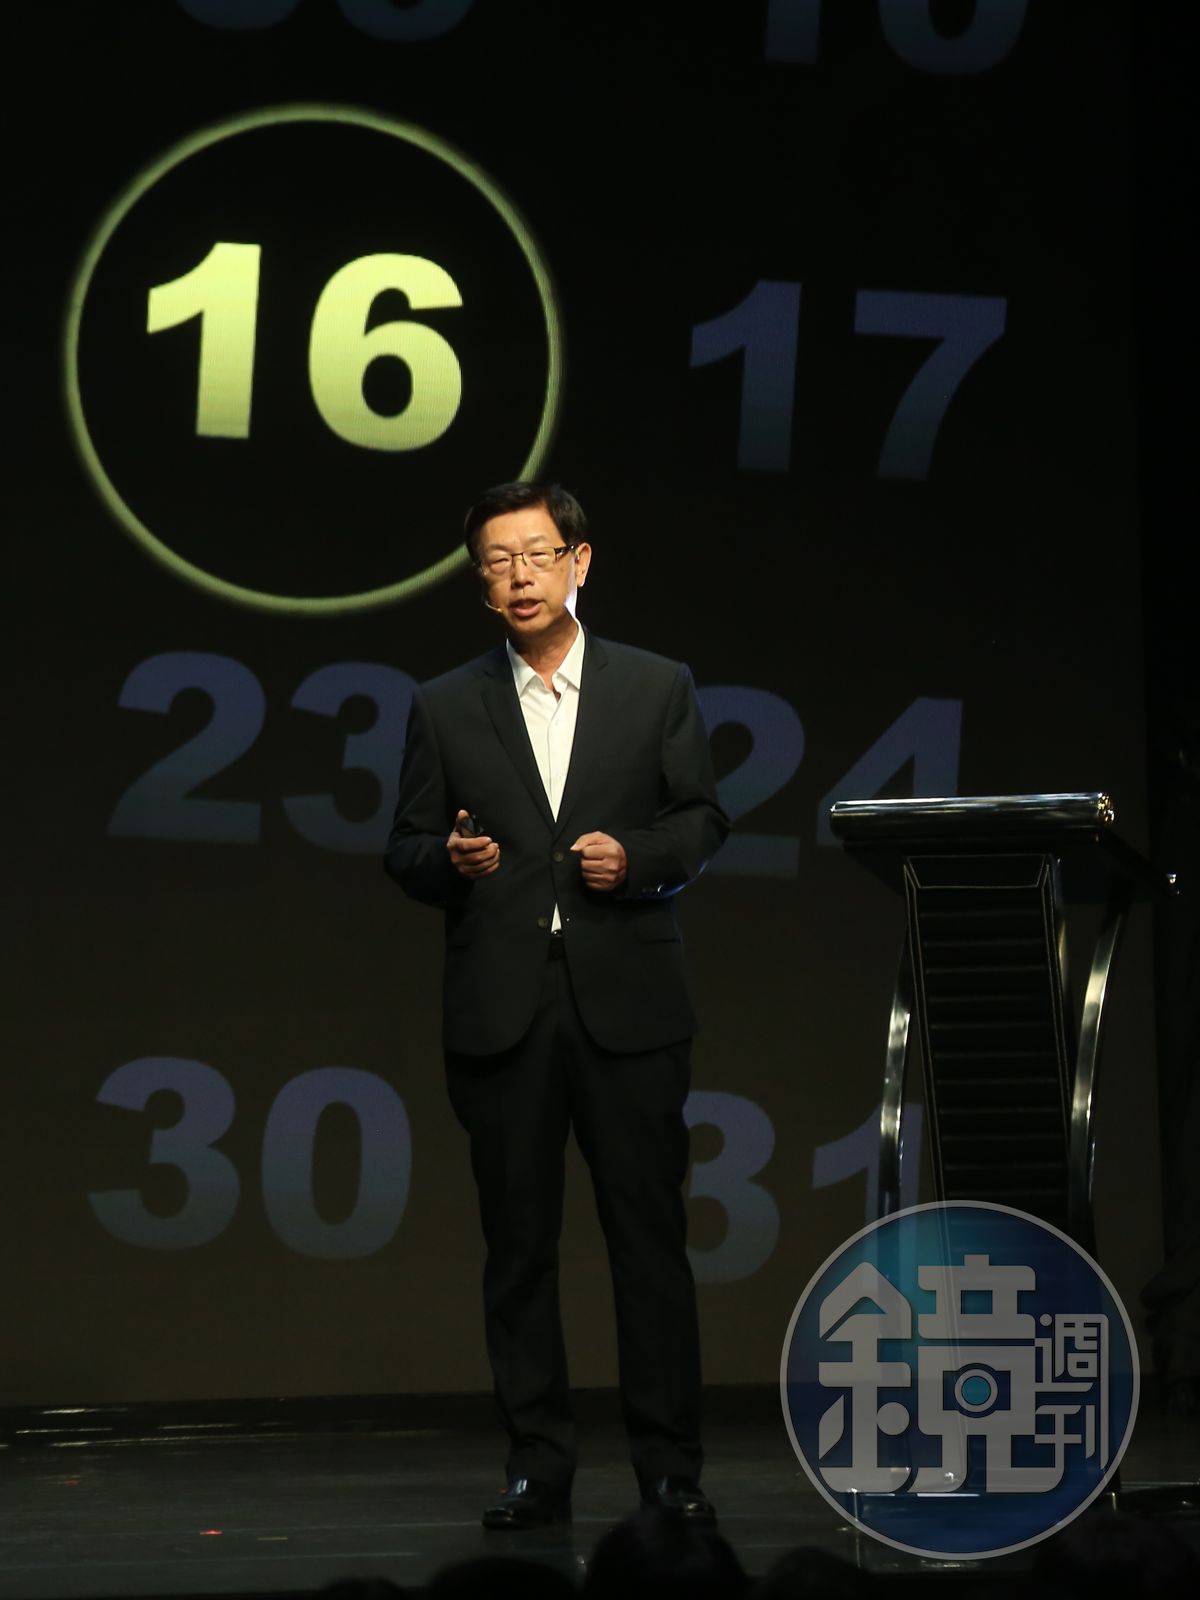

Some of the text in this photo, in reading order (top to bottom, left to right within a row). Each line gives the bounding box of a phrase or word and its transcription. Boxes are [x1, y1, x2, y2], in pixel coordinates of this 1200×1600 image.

[146, 241, 463, 453] 16
[689, 279, 1007, 481] 17
[107, 650, 420, 855] 23
[88, 1056, 412, 1260] 30
